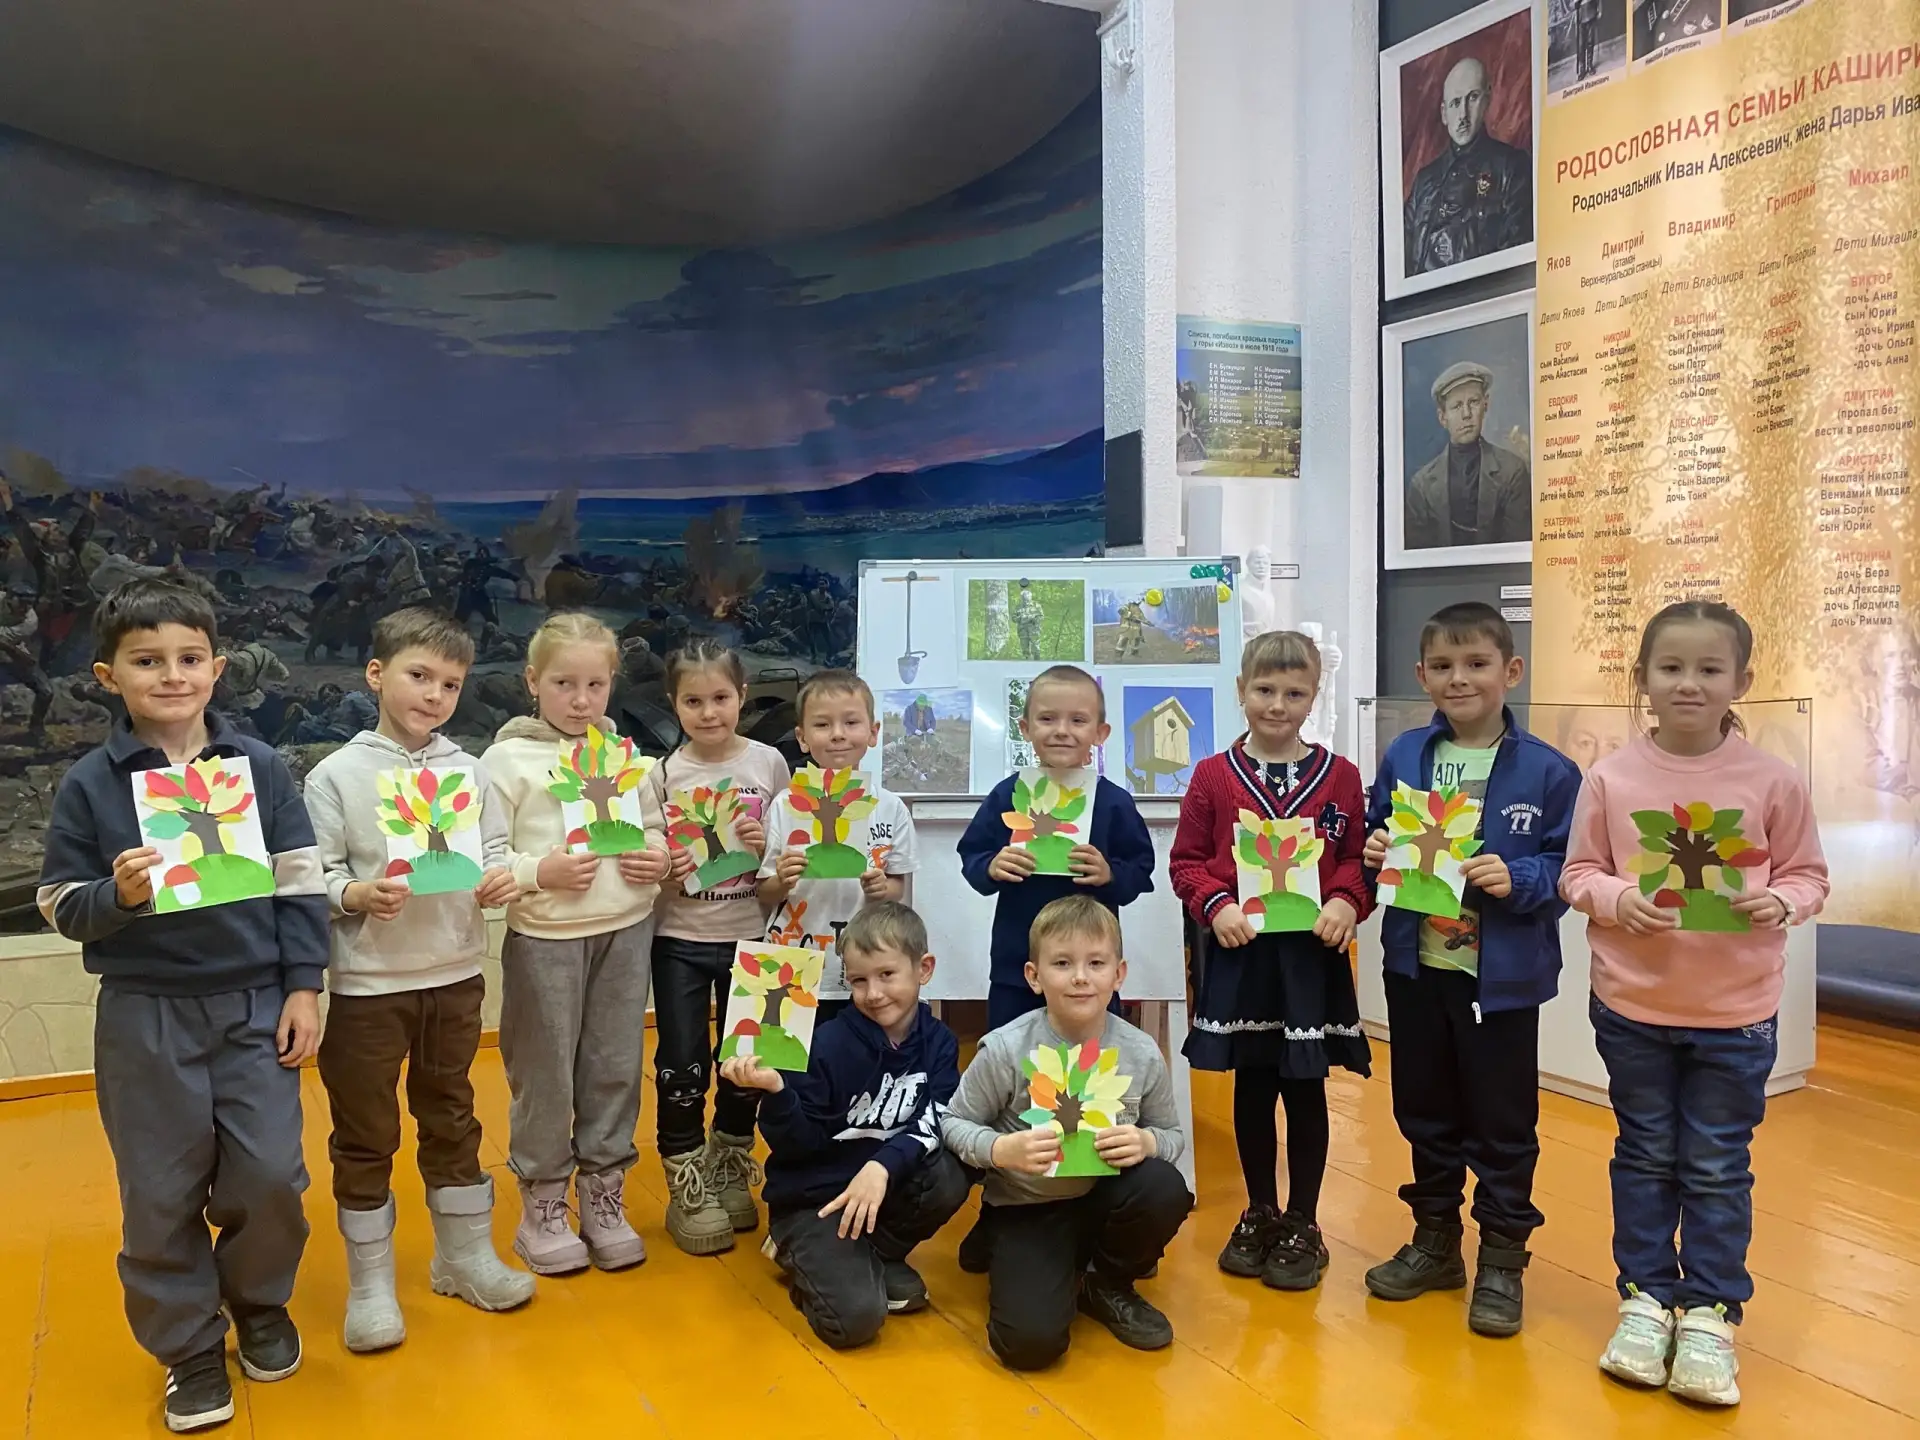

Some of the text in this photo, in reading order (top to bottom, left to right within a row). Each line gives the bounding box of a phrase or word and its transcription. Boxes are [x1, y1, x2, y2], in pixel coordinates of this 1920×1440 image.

[1557, 110, 1719, 183] РОДОСЛОВНАЯ
[1728, 76, 1805, 128] СЕМЬИ
[1572, 169, 1662, 212] Родоначальник
[1665, 160, 1704, 182] Иван
[1708, 132, 1793, 173] Алексеевич,
[1795, 116, 1825, 143] жена
[1830, 103, 1885, 133] Дарья
[1849, 164, 1909, 187] Михаил
[1766, 180, 1816, 215] Григорий
[1668, 212, 1736, 237] Владимир
[1601, 231, 1645, 260] Дмитрий
[1834, 229, 1917, 253] Дети Михаила
[1547, 256, 1571, 272] Яков
[1758, 261, 1781, 276] Дети
[1662, 270, 1744, 295] Дети Владимира
[1850, 272, 1893, 288] ВИКТОР
[1595, 290, 1648, 314] Дети Дмитрия
[1845, 290, 1898, 306] дочь Анна
[1540, 306, 1585, 325] Дети Якова
[1674, 310, 1717, 326] ВАСИЛИЙ
[1845, 305, 1897, 321] сын Юрий
[1668, 325, 1725, 342] сын Геннадий
[1887, 320, 1915, 334] Ирина
[1262, 344, 1275, 352] 1918
[1555, 341, 1572, 353] ЕГОР
[1668, 341, 1722, 356] сын Дмитрий
[1887, 336, 1914, 349] Ольга
[1540, 353, 1579, 369] сын Василий
[1595, 351, 1609, 359] сын
[1885, 354, 1909, 366] Анна
[1604, 363, 1617, 372] сын
[1668, 361, 1685, 371] сын
[1540, 367, 1588, 384] дочь Анастасия
[1668, 372, 1721, 386] сын Клавдия
[1680, 387, 1718, 399] сын Олег
[1545, 409, 1582, 421] сын Михаил
[1837, 405, 1898, 421] (пропал без
[1596, 420, 1610, 428] сын
[1670, 414, 1718, 429] АЛЕКСАНДР
[1815, 426, 1844, 437] вести
[1856, 416, 1917, 435] революцию)
[1595, 433, 1610, 443] дочь
[1667, 432, 1704, 445] дочь Зоя
[1543, 448, 1582, 461] сын Николай
[1603, 445, 1618, 456] дочь
[1678, 445, 1726, 459] дочь Римма
[1678, 460, 1722, 473] сын Борис
[1839, 453, 1895, 467] АРИСТАРХ
[1677, 473, 1730, 487] сын Валерий
[1821, 471, 1865, 484] Николай
[1540, 489, 1585, 502] Детей не было
[1595, 488, 1610, 498] дочь
[1666, 490, 1707, 503] дочь Тоня
[1821, 485, 1911, 500] Вениамин Михаил
[1820, 504, 1876, 517] сын Борис
[1819, 520, 1872, 533] сын Юрий
[1540, 529, 1585, 542] Детей не было
[1666, 533, 1719, 546] сын Дмитрий
[1835, 550, 1892, 563] АНТОНИНА
[1837, 567, 1890, 580] дочь Вера
[1664, 577, 1720, 588] сын Анатолий
[1823, 583, 1902, 597] сын Александр
[1663, 594, 1683, 604] дочь
[1824, 599, 1899, 612] дочь Людмила
[1594, 611, 1606, 619] сын
[1831, 615, 1893, 628] дочь Римма
[1432, 763, 1466, 787] ADY
[1501, 803, 1543, 817] REKINDLING
[1510, 811, 1532, 831] 77
[870, 822, 892, 841] RISE
